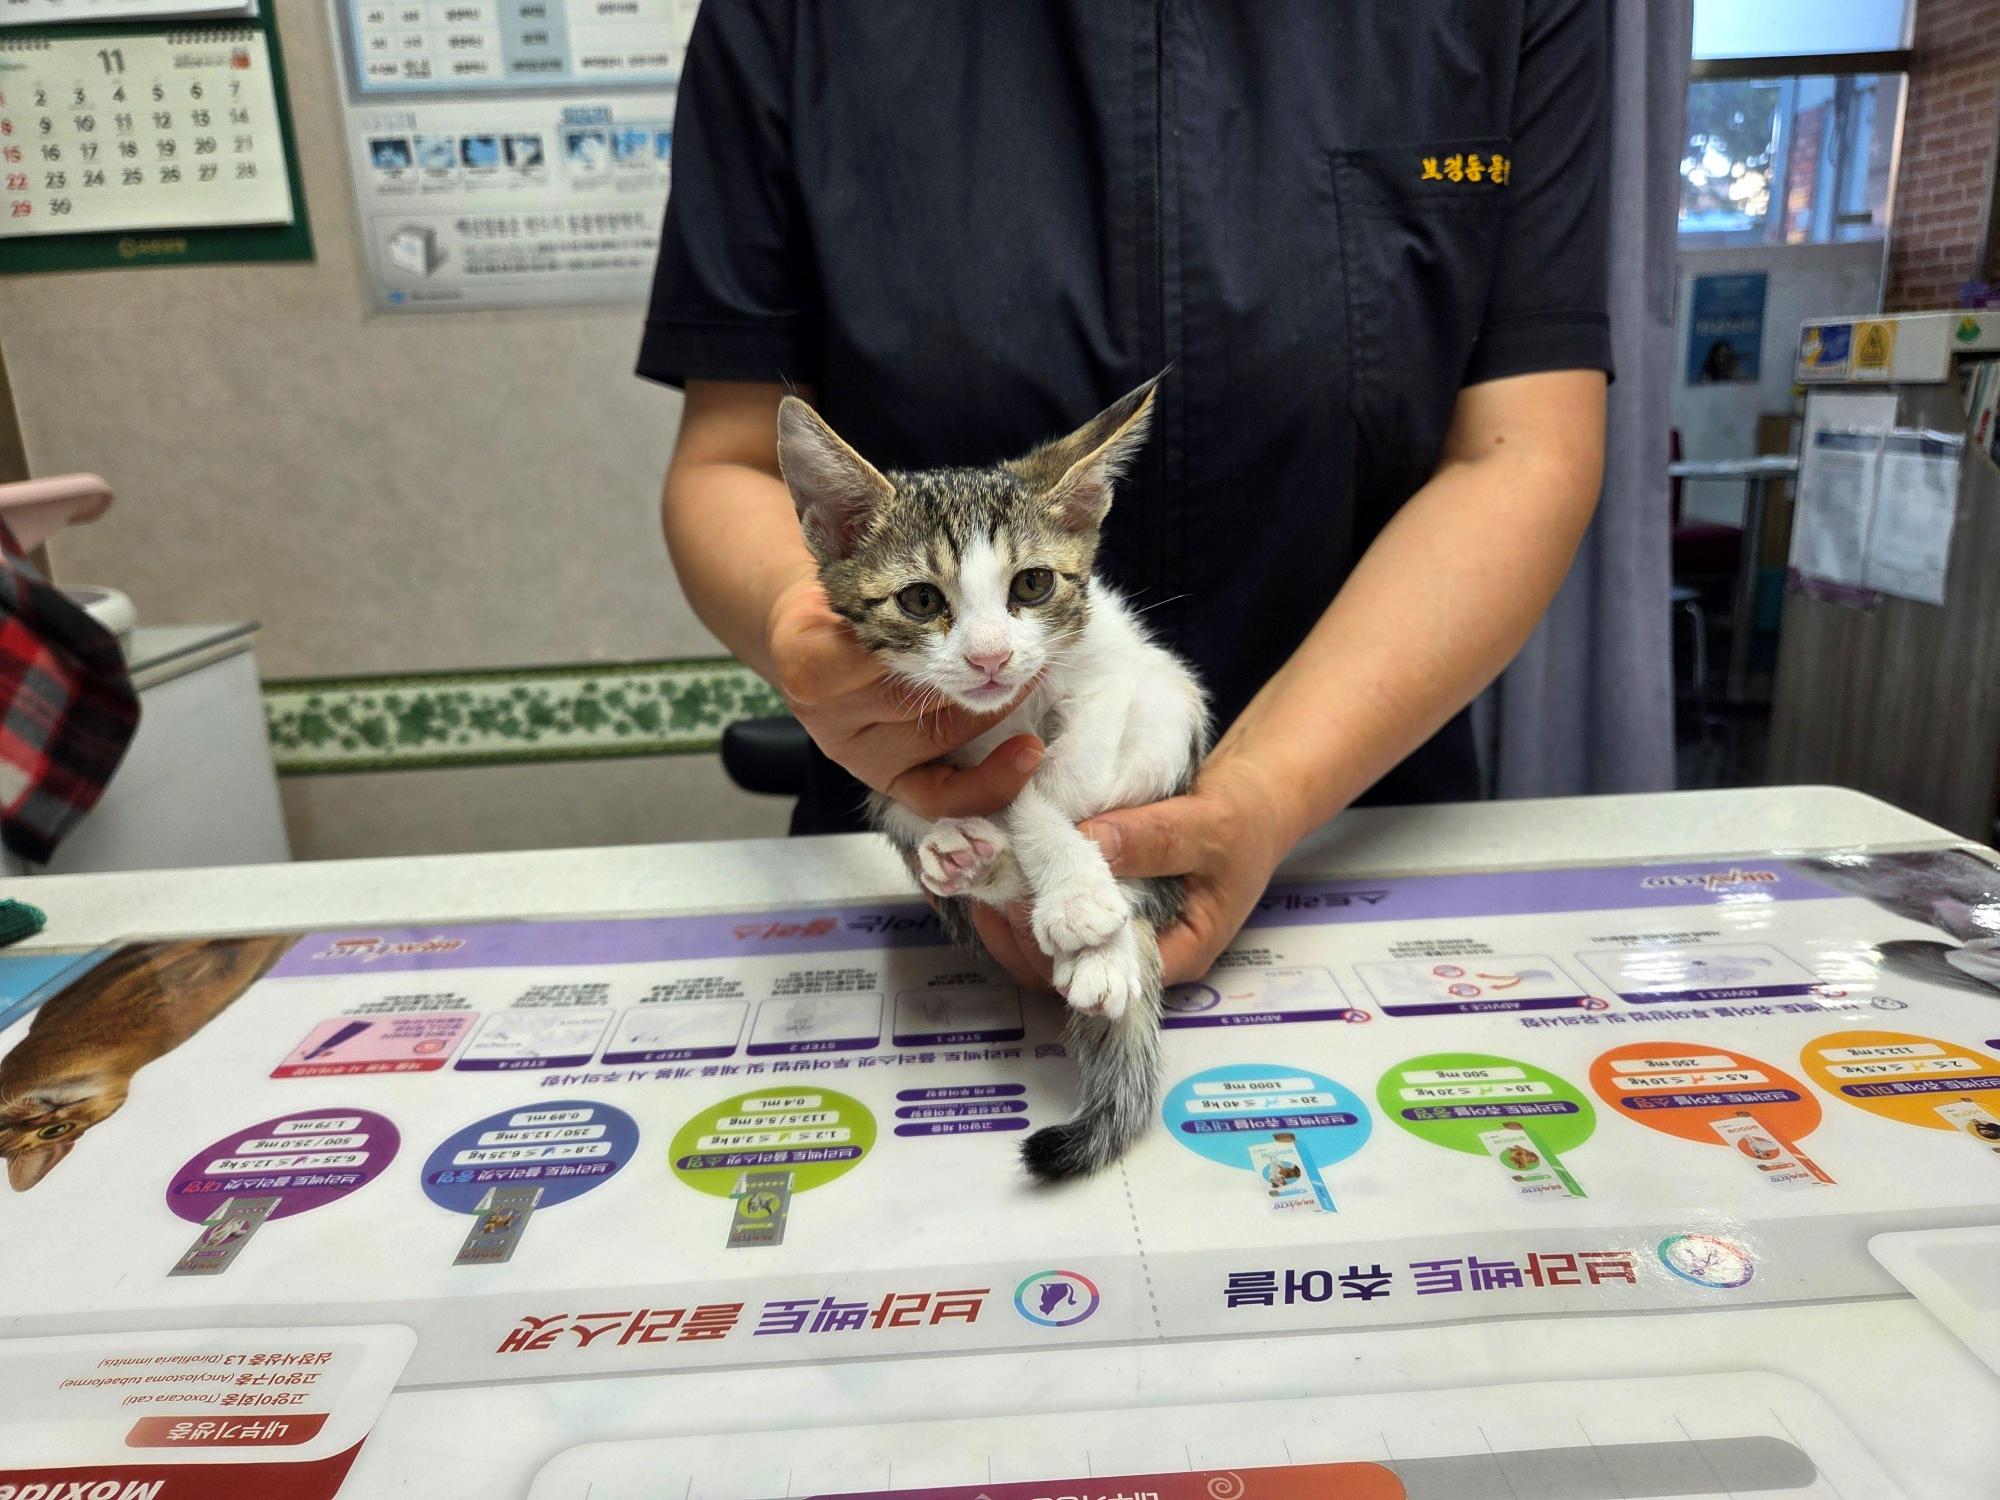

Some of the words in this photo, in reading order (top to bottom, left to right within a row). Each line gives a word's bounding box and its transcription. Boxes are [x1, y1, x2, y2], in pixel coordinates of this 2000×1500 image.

[97, 48, 125, 74] 11
[34, 89, 46, 107] 2
[73, 86, 85, 105] 3
[113, 87, 126, 102] 4
[152, 84, 164, 102] 5
[190, 81, 203, 100] 6
[229, 80, 240, 98] 7
[39, 116, 51, 134] 9
[73, 115, 95, 132] 10
[114, 113, 133, 131] 11
[152, 111, 172, 129] 12
[191, 109, 210, 128] 13
[229, 107, 249, 125] 14
[2, 145, 22, 163] 15
[40, 143, 60, 161] 16
[80, 142, 98, 160] 17
[119, 141, 138, 158] 18
[157, 138, 176, 157] 19
[194, 136, 217, 155] 20
[233, 135, 254, 153] 21
[1421, 153, 1511, 185] 보경동물
[6, 173, 28, 190] 22
[46, 171, 66, 189] 23
[82, 169, 105, 187] 24
[122, 167, 143, 185] 25
[159, 166, 181, 183] 26
[198, 163, 218, 182] 27
[235, 162, 258, 180] 28
[11, 200, 32, 217] 29
[48, 198, 72, 216] 30
[1467, 1001, 1520, 1010] ADVICE
[1712, 1005, 1774, 1016] 츄어블
[1220, 1016, 1228, 1024] 3
[1231, 1014, 1282, 1023] ADVICE
[1519, 1014, 1598, 1028] 유의사항
[1602, 1012, 1626, 1024] 및
[1628, 1010, 1710, 1022] 투여방법
[948, 1034, 982, 1043] STEP
[802, 1042, 836, 1050] STEP
[1874, 1046, 1914, 1055] 112.5
[658, 1051, 692, 1059] STEP
[943, 1048, 1022, 1061] 브라벡토
[1847, 1047, 1872, 1056] mg
[510, 1060, 548, 1068] STEP
[857, 1052, 936, 1068] 플러스캣
[1644, 1058, 1670, 1068] mg
[1672, 1058, 1699, 1066] 250
[1950, 1060, 1962, 1068] 2
[702, 1064, 740, 1076] 제품
[746, 1062, 764, 1074] 및
[772, 1058, 850, 1073] 투여방법
[1841, 1064, 1862, 1074] kg
[1864, 1064, 1887, 1073] 4.5
[628, 1070, 644, 1081] 시
[655, 1068, 694, 1080] 개봉
[1436, 1070, 1460, 1079] mg
[1463, 1070, 1488, 1078] 500
[1725, 1072, 1748, 1081] 4.5
[540, 1072, 622, 1087] 주의사항
[1626, 1076, 1647, 1086] kg
[1650, 1076, 1668, 1084] 10
[1223, 1082, 1246, 1091] mg
[1249, 1082, 1282, 1090] 1000
[1516, 1084, 1532, 1093] 10
[1852, 1084, 1894, 1096] 미니
[1892, 1081, 1940, 1093] 츄어블
[1414, 1088, 1434, 1097] kg
[1436, 1088, 1454, 1096] 20
[1722, 1090, 1790, 1102] 브라벡토
[760, 1100, 781, 1108] mL
[784, 1098, 805, 1108] 0.4
[1222, 1100, 1239, 1108] 40
[1302, 1096, 1318, 1104] 20
[1674, 1094, 1721, 1104] 츄어블
[1202, 1100, 1220, 1109] kg
[1502, 1103, 1568, 1114] 브라벡토
[1452, 1106, 1500, 1116] 츄어블
[526, 1114, 546, 1122] mL
[549, 1112, 580, 1122] 0.89
[729, 1116, 752, 1126] mg
[755, 1116, 777, 1126] 5.6
[789, 1114, 826, 1123] 112.5
[1234, 1116, 1280, 1128] 츄어블
[1282, 1114, 1346, 1126] 브라벡토
[291, 1122, 312, 1131] mL
[315, 1120, 347, 1130] 1.79
[932, 1124, 954, 1132] 체중
[958, 1122, 992, 1130] 고양이
[1194, 1120, 1230, 1132] 대형
[496, 1130, 520, 1140] mg
[522, 1130, 552, 1140] 12.5
[564, 1128, 592, 1137] 250
[816, 1131, 838, 1140] 1.2
[256, 1138, 279, 1150] mg
[280, 1138, 312, 1148] 25.0
[324, 1137, 351, 1147] 500
[712, 1136, 728, 1146] kg
[730, 1136, 754, 1145] 2.8
[576, 1145, 598, 1154] 2.8
[792, 1148, 854, 1160] 브라벡토
[324, 1154, 356, 1164] 6.25
[467, 1150, 486, 1160] kg
[488, 1150, 521, 1160] 6.25
[727, 1150, 788, 1164] 플러스캣
[218, 1158, 239, 1170] kg
[241, 1160, 272, 1170] 12.5
[686, 1154, 726, 1168] 소형
[478, 1166, 542, 1180] 플러스캣
[546, 1162, 608, 1175] 브라벡토
[224, 1175, 291, 1190] 플러스캣
[293, 1174, 360, 1186] 브라벡토
[1409, 1251, 1637, 1296] 브라벡토
[1223, 1264, 1392, 1309] 츄어블
[752, 1288, 992, 1336] 브라벡토
[495, 1301, 746, 1354] 플러스캣
[98, 1356, 156, 1368] immitis)
[158, 1353, 224, 1366] (Dirofilaria
[224, 1354, 246, 1366] L3
[248, 1352, 334, 1367] 심장사상충
[60, 1376, 142, 1389] tubaeforme)
[144, 1372, 234, 1386] (Ancylostoma
[235, 1372, 322, 1386] 고양이구충
[122, 1394, 153, 1407] cati)
[156, 1392, 220, 1404] (Toxocara
[220, 1392, 310, 1406] 고양이회충
[167, 1420, 290, 1440] 내부기생충
